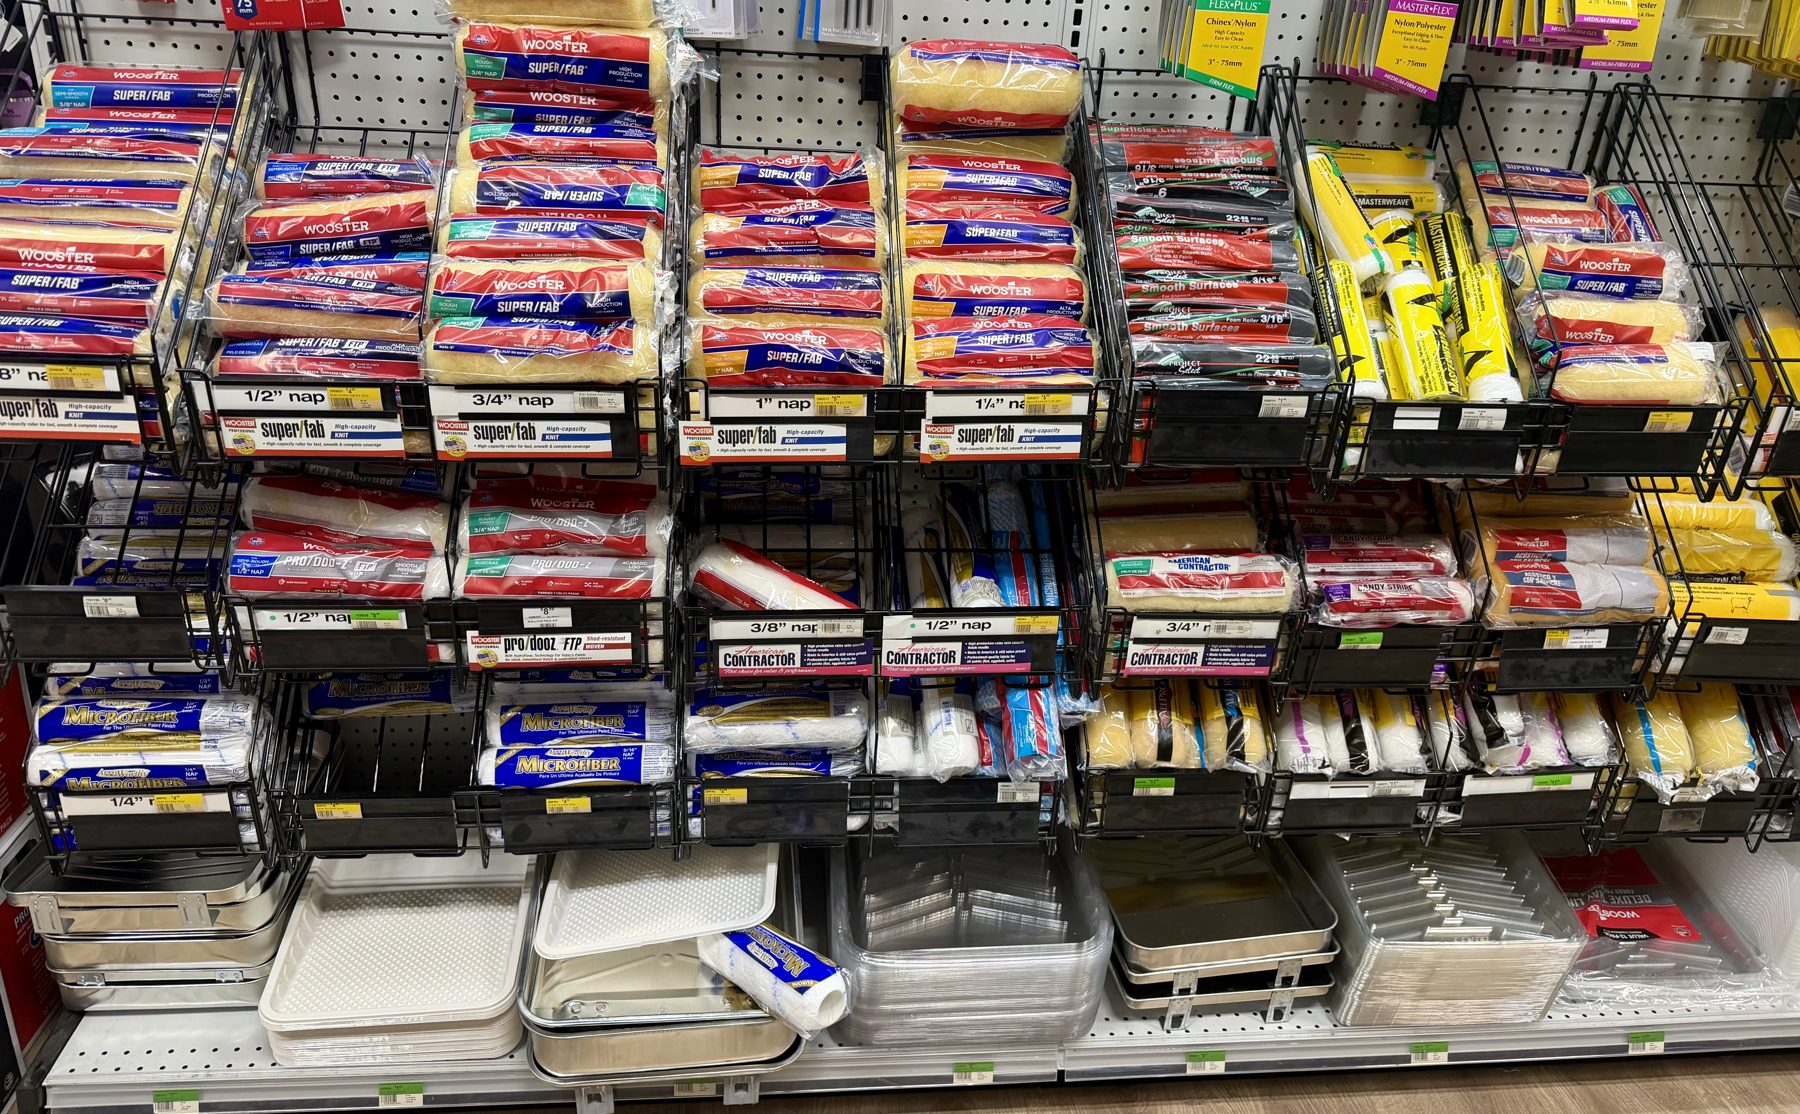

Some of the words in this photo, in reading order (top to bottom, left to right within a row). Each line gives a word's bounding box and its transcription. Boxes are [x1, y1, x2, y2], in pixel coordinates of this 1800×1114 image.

[1584, 16, 1617, 24] MEDIUM-FIRM
[1551, 25, 1584, 35] MEDIUM-FIRM
[523, 35, 587, 53] WOOSTER
[528, 62, 584, 75] SUPER/FAB
[1407, 60, 1427, 68] 75mm
[114, 71, 178, 80] WOOSTER
[1209, 79, 1221, 87] FIRM
[1222, 82, 1235, 90] FLEX
[1412, 84, 1427, 94] FLEX
[113, 90, 171, 101] SUPER/FAB
[530, 92, 596, 105] WOOSTER
[109, 111, 176, 119] WOOSTER
[536, 114, 592, 124] SUPER/FAB
[533, 125, 592, 134] SUPER/FAB
[963, 161, 1021, 170] WOOSTER
[1505, 164, 1550, 172] SUPER/FAB
[759, 169, 812, 181] SUPER/FAB
[760, 200, 820, 214] WOOSTER
[1358, 198, 1410, 206] MASTERWEAVE
[1523, 215, 1571, 224] WOOSTER
[304, 221, 369, 234] WOOSTER
[517, 222, 577, 232] SUPER/FAB
[966, 228, 1017, 237] SUPER/FAB
[1178, 236, 1224, 246] Surfaces
[1432, 215, 1451, 281] MASTERWEAVE
[18, 247, 94, 263] WOOSTER
[1580, 258, 1630, 271] WOOSTER
[11, 275, 80, 289] SUPER/FAB
[494, 275, 564, 291] WOOSTER
[1142, 284, 1185, 292] Smooth
[1190, 281, 1239, 290] Surfaces
[1574, 280, 1625, 292] SUPER/FAB
[970, 282, 1031, 296] WOOSTER
[498, 301, 560, 313] SUPER/FAB
[973, 306, 1027, 316] SUPER/FAB
[972, 319, 1032, 329] WOOSTER
[1144, 323, 1187, 331] Smooth
[1191, 323, 1239, 332] Surfaces
[762, 330, 826, 344] WOOSTER
[978, 334, 1033, 344] SUPER/FAB
[1566, 329, 1614, 343] WOOSTER
[767, 351, 822, 364] SUPER/FAB
[1179, 366, 1200, 374] Select
[28, 371, 48, 381] na
[245, 390, 282, 403] 1/2”
[289, 392, 325, 405] nap
[472, 395, 512, 405] 3/4”
[519, 397, 554, 408] nap
[69, 403, 111, 411] High-capacity
[756, 398, 772, 408] 1”
[778, 400, 811, 411] nap
[1009, 401, 1024, 409] na
[261, 420, 325, 440] super/fab
[474, 423, 536, 442] super/fab
[718, 426, 776, 445] super/fab
[958, 425, 1015, 444] super/fab
[531, 498, 595, 509] WOOSTER
[1358, 584, 1385, 592] CANDY
[284, 613, 319, 622] 1/2”
[751, 623, 786, 632] 3/8”
[926, 621, 957, 630] 1/2”
[962, 622, 991, 631] nap
[1166, 622, 1199, 632] 3/4”
[564, 637, 582, 650] FTP
[898, 643, 946, 652] American
[1142, 644, 1189, 653] American
[735, 645, 785, 654] American
[724, 653, 795, 667] CONTRACTOR
[887, 651, 956, 664] CONTRACTOR
[1131, 652, 1198, 666] CONTRACTOR
[520, 713, 625, 731] MICROFIBER
[515, 756, 620, 774] MICROFIBER
[110, 797, 143, 807] 1/4”
[1612, 895, 1652, 904] DELUXE
